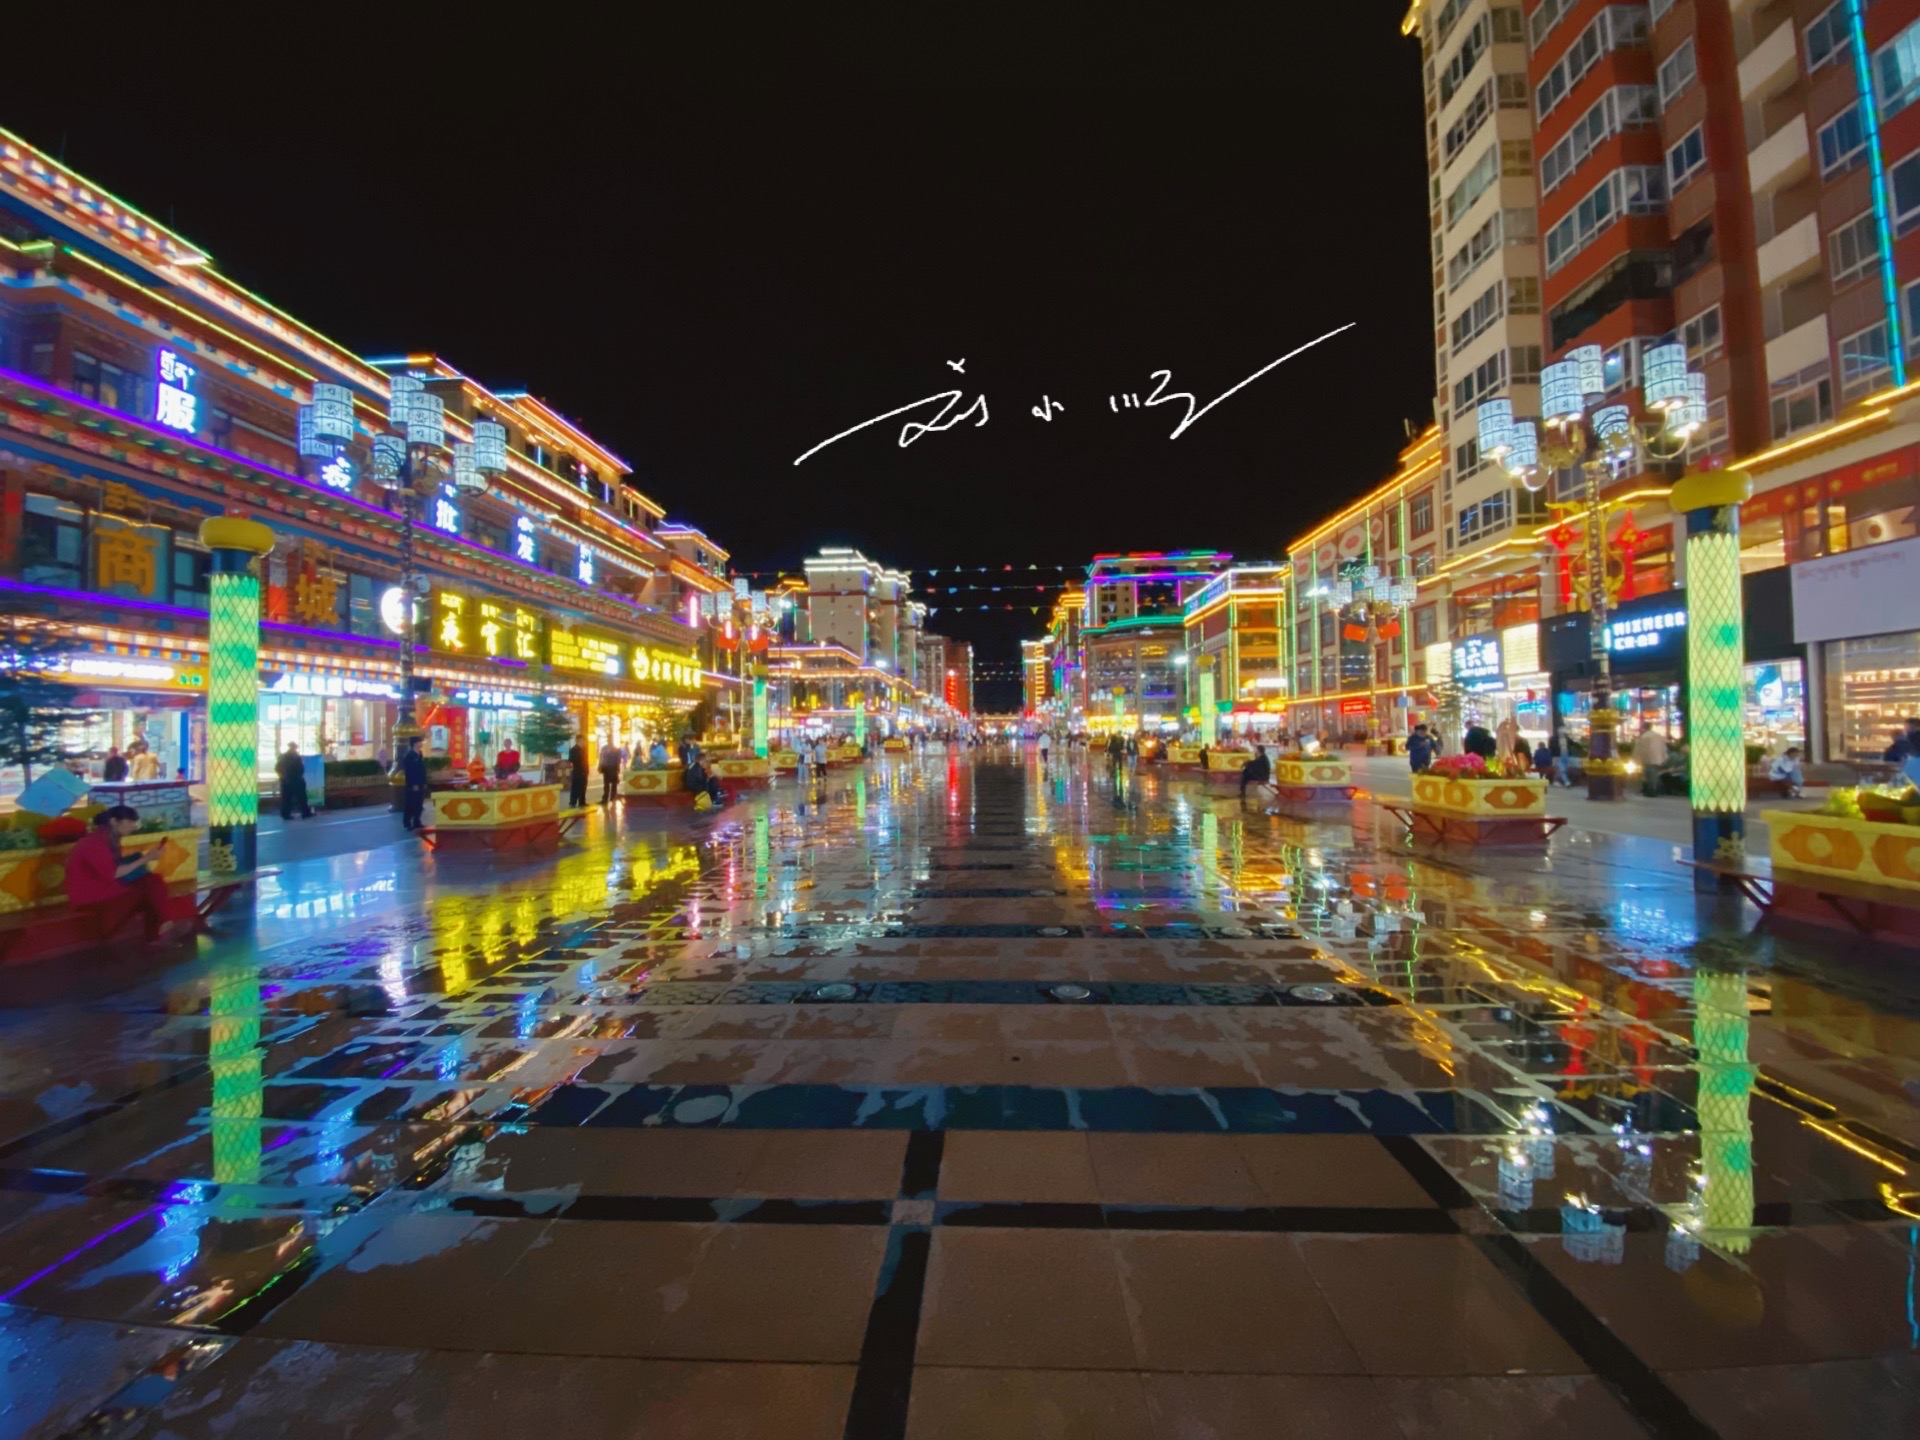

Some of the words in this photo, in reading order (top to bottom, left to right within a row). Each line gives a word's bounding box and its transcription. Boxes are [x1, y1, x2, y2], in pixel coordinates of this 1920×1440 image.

[157, 382, 195, 433] 服
[95, 528, 158, 596] 商
[295, 573, 339, 626] 城
